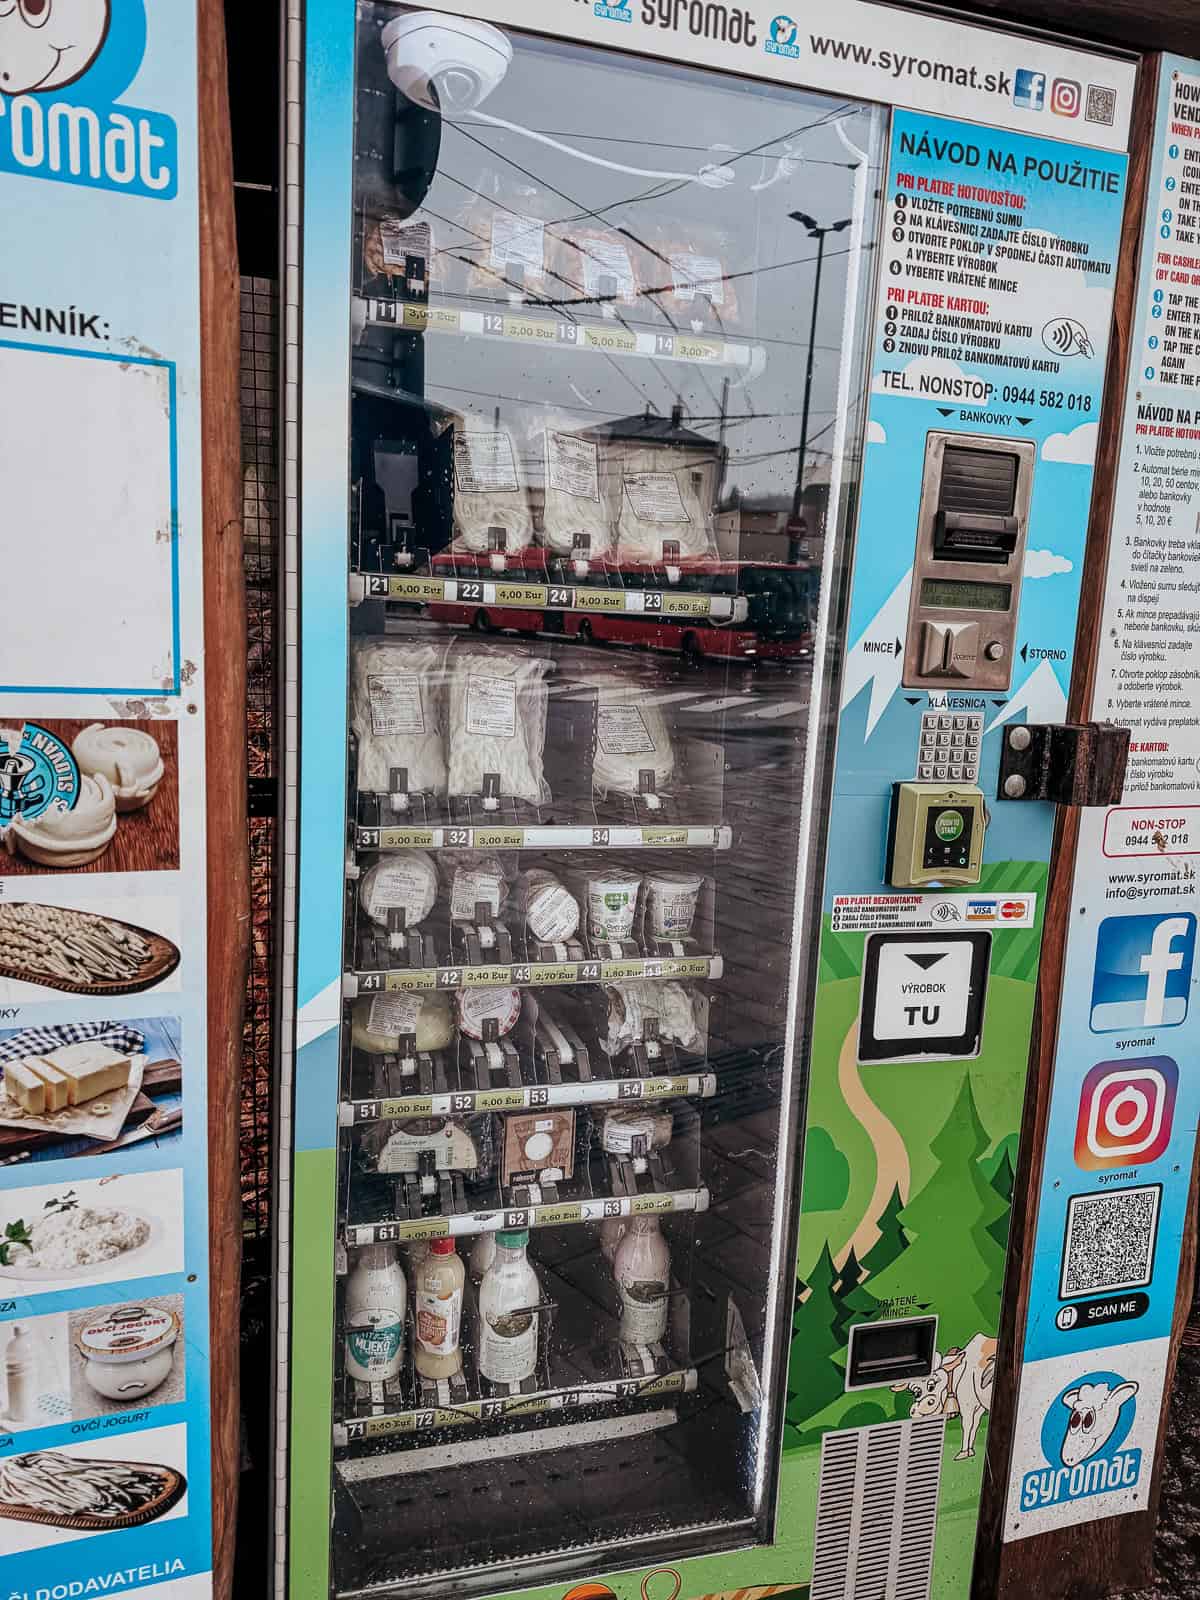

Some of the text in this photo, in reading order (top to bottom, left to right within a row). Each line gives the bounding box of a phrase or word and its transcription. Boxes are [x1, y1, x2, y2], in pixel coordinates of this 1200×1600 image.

[810, 35, 1011, 97] www.syromat.sk
[1175, 82, 1200, 101] HOW
[1171, 122, 1192, 138] WHEN
[900, 130, 1120, 194] NÁVOD NA POUŽITIE
[896, 173, 1027, 209] PRI PLATBE HOTOVOSŤOU:
[911, 195, 1023, 227] VLOŽTE POTREBNÚ SUMU
[909, 214, 1089, 254] NA KLÁVESNICI ZADAJTE ČÍSLO VÝROBKU
[906, 248, 998, 273] A VYBERTE VÝROBOK
[908, 232, 1112, 275] OTVORTE POKLOP V SPODNEJ ČASTI AUTOMATU
[1157, 252, 1172, 265] FOR
[905, 264, 1019, 293] VYBERTE VRÁTENÉ MINCE
[1170, 271, 1189, 284] CARD
[887, 287, 990, 316] PRI PLATBE KARTOU:
[1168, 293, 1199, 308] TAP THE
[0, 303, 110, 341] ENNÍK:
[901, 308, 1033, 338] PRILOŽ BANKOMATOVÚ KARTU
[1166, 309, 1192, 322] ENTER
[377, 302, 396, 318] 11
[484, 315, 502, 331] 12
[559, 324, 577, 339] 13
[656, 336, 673, 350] 14
[900, 324, 1001, 350] ZADAJ ČÍSLO VÝROBKU
[1163, 340, 1193, 355] TAP THE
[898, 341, 1060, 373] ZNOVU PRILOŽ BANKOMATOVÚ KARTU
[1161, 356, 1186, 369] AGAIN
[1159, 371, 1195, 386] TAKE THE
[881, 370, 1092, 412] TEL. NONSTOP: 0944 582 018
[959, 409, 1013, 427] BANKOVKY
[1137, 402, 1191, 424] NÁVOD NA
[1136, 424, 1175, 438] PRI PLATBE
[1144, 445, 1166, 457] Vložte
[1141, 463, 1170, 476] Automat
[1138, 489, 1192, 504] alebo bankovky
[1143, 502, 1172, 514] hodnote
[371, 577, 388, 592] 21
[462, 583, 480, 598] 22
[525, 591, 544, 601] Eur
[550, 589, 568, 603] 24
[603, 597, 621, 607] Eur
[645, 594, 661, 608] 23
[863, 641, 894, 653] MINCE
[1029, 648, 1067, 660] STORNO
[1145, 669, 1168, 681] poklop
[1123, 681, 1154, 691] odoberte
[928, 695, 987, 708] KLÁVESNICA
[1178, 757, 1195, 766] kartu
[1147, 769, 1174, 780] výrobku
[1131, 818, 1187, 831] NON-STOP
[362, 830, 379, 844] 31
[414, 836, 431, 845] Eur
[449, 830, 467, 844] 32
[503, 835, 521, 844] Eur
[593, 829, 609, 842] 34
[1125, 833, 1189, 847] 0944 018
[1108, 869, 1196, 885] www.syromat.sk
[1105, 884, 1196, 901] info@syromat.sk
[973, 906, 992, 915] VISA
[364, 975, 381, 989] 41
[441, 972, 458, 985] 42
[491, 971, 510, 982] Eur
[558, 971, 575, 980] Eur
[582, 965, 598, 977] 44
[901, 981, 947, 994] VÝROBOK
[904, 1005, 941, 1026] TU
[1115, 1036, 1156, 1050] syromat
[360, 1104, 376, 1118] 51
[413, 1103, 430, 1113] Eur
[455, 1095, 473, 1109] 52
[505, 1096, 522, 1106] Eur
[531, 1089, 547, 1103] 53
[623, 1083, 639, 1096] 54
[1098, 1169, 1138, 1184] syromat
[508, 1202, 620, 1226] 62 63
[1088, 1301, 1137, 1320] SCAN ME
[417, 1382, 637, 1427] 72 75
[71, 1411, 152, 1434] OVČI JOGURT
[1022, 1454, 1137, 1508] syromat
[36, 1558, 186, 1600] DODAVATELIA
